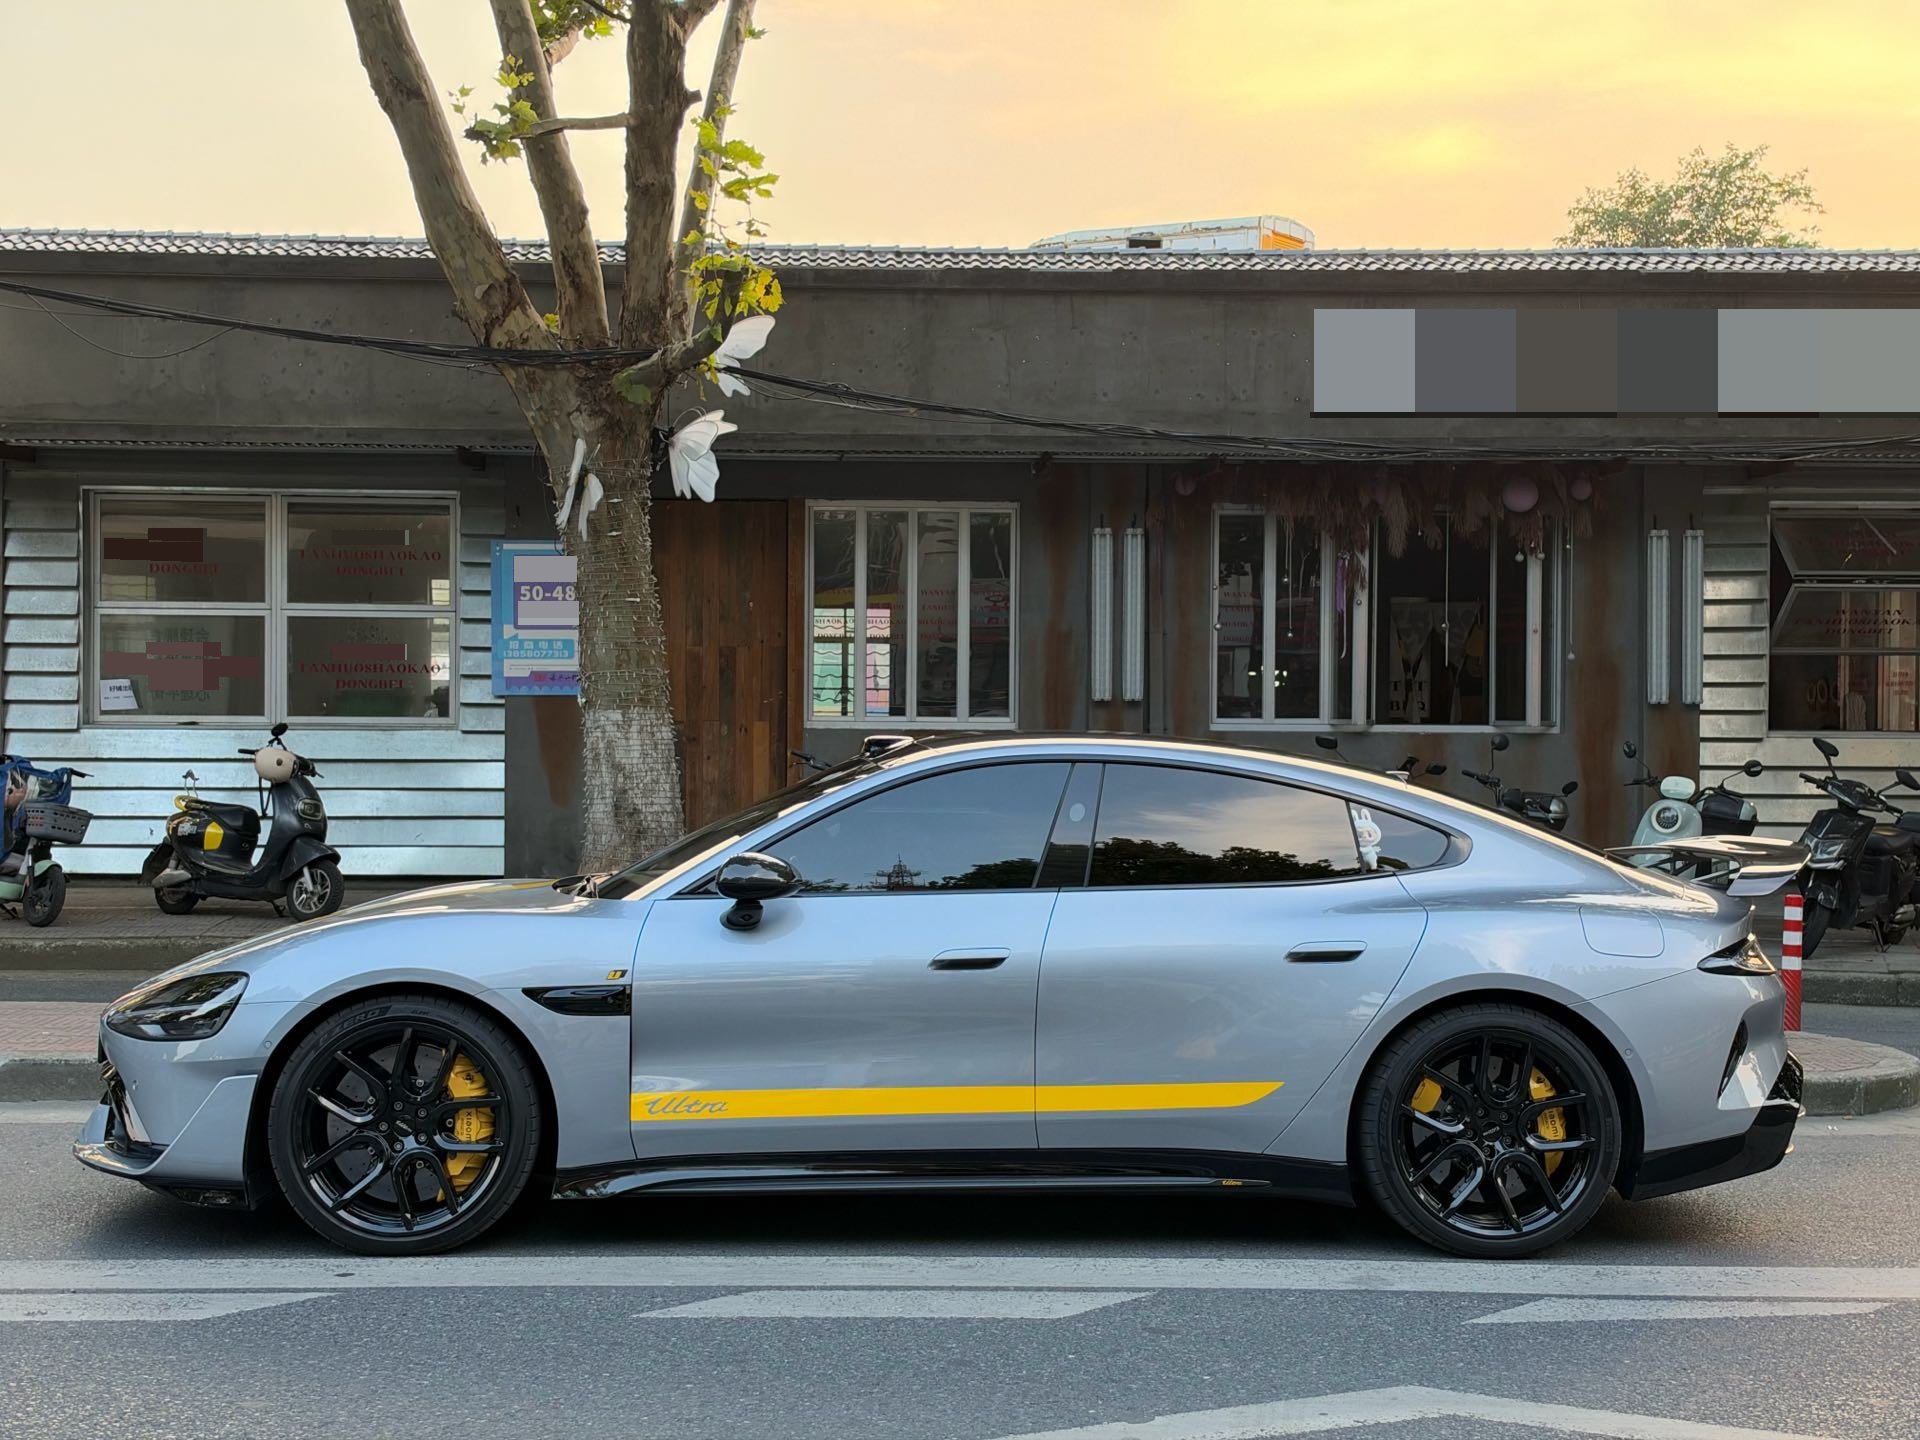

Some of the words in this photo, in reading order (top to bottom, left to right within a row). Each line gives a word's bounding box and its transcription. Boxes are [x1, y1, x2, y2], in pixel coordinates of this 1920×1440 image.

[335, 679, 404, 689] DONGBEI
[645, 1094, 729, 1116] Ultra
[465, 1111, 473, 1144] xiaom
